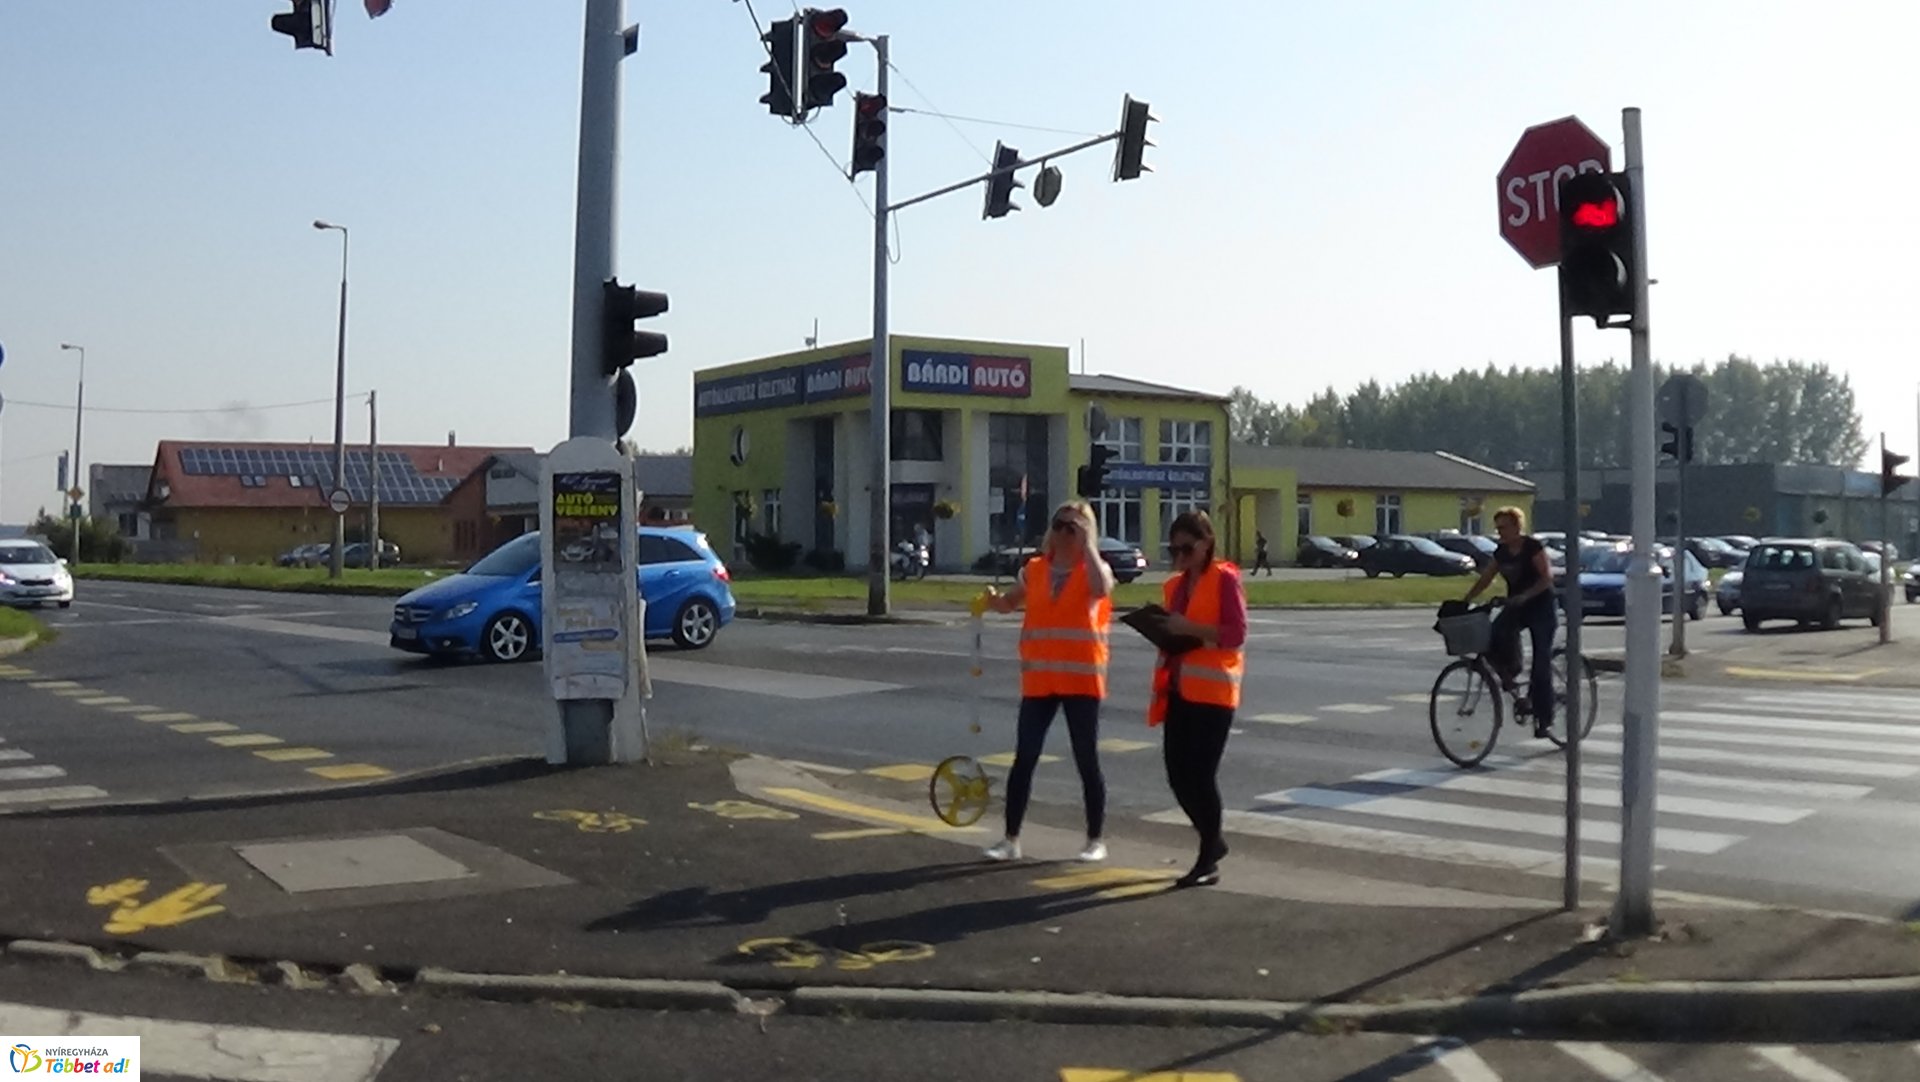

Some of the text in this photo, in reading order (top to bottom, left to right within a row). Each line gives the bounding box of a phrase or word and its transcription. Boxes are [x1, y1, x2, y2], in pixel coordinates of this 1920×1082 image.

[1506, 159, 1604, 227] STO
[807, 369, 842, 393] BÁRDI
[907, 358, 1026, 388] BÁRDI AUTÓ
[556, 492, 594, 505] AUTÓ
[556, 505, 618, 516] VERSENY
